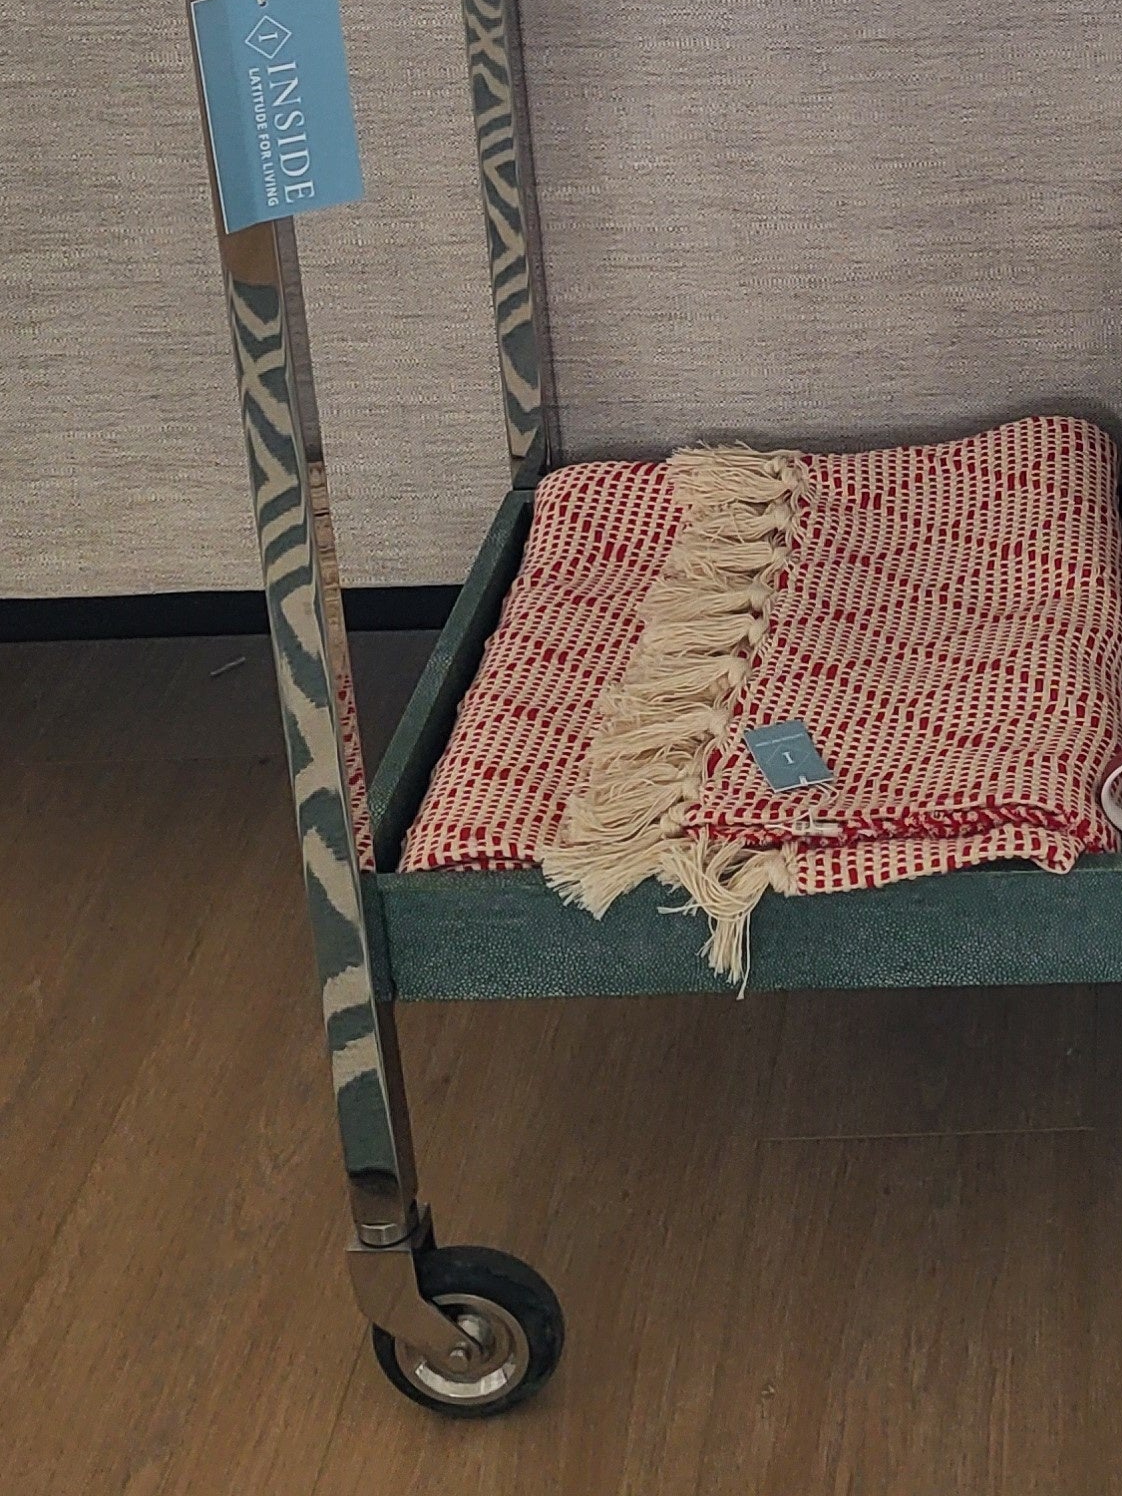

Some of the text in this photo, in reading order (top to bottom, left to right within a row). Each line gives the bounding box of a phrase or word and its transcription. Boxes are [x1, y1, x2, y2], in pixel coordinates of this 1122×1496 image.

[248, 67, 280, 207] LATITUDE FOR LIVING
[267, 60, 316, 204] INSIDE
